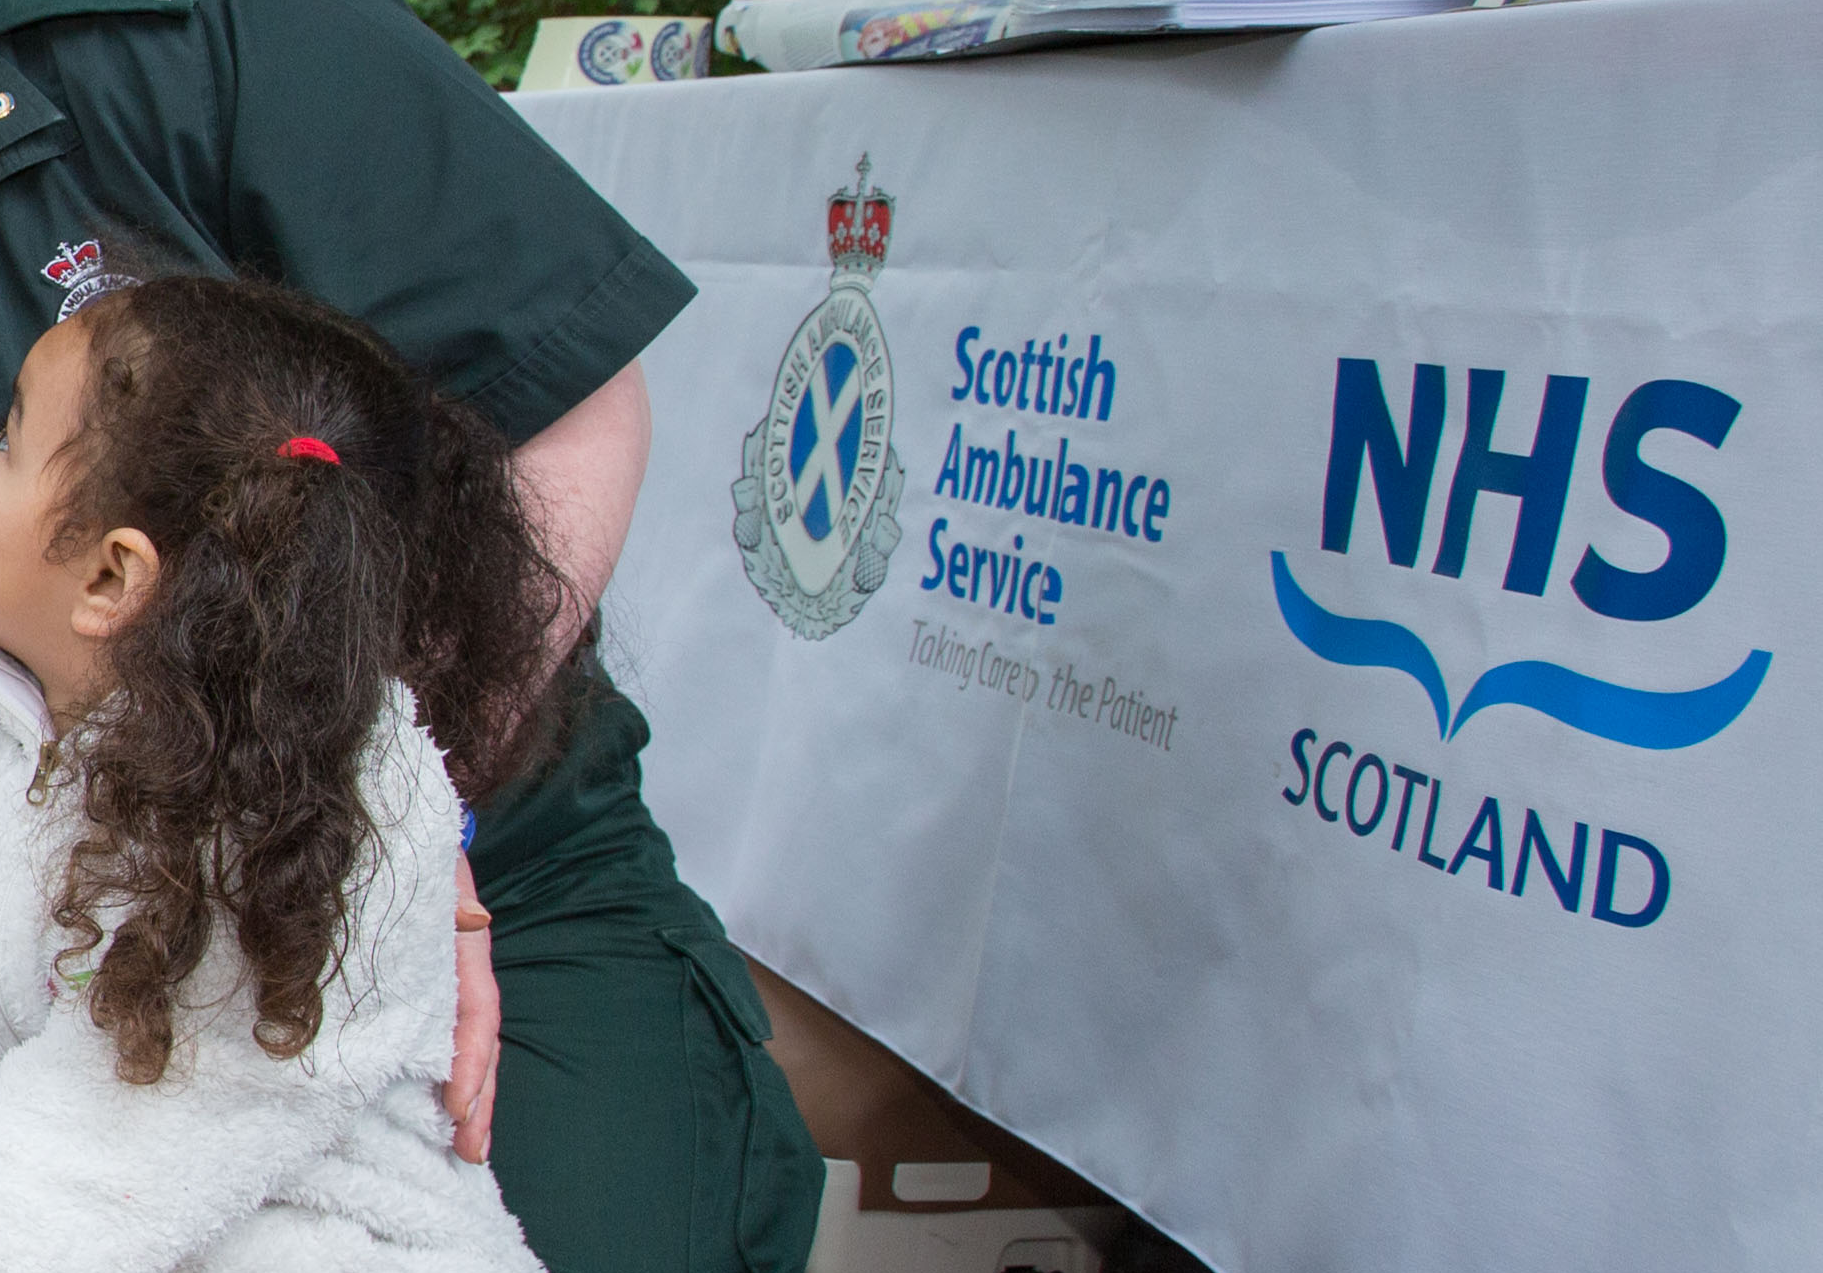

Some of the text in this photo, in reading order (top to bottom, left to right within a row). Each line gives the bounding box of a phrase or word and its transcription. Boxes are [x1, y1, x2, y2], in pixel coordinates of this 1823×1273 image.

[951, 326, 1116, 422] Scottish
[768, 348, 809, 525] SCOTTISH
[840, 389, 885, 551] SERVICE
[934, 422, 1170, 543] Ambulance
[1321, 357, 1742, 622] NHS
[920, 517, 1063, 625] Service
[909, 619, 978, 691] Taking
[978, 641, 1021, 695] Care
[1046, 663, 1094, 719] the
[1095, 676, 1178, 752] Patient
[1282, 728, 1671, 929] SCOTLAND
